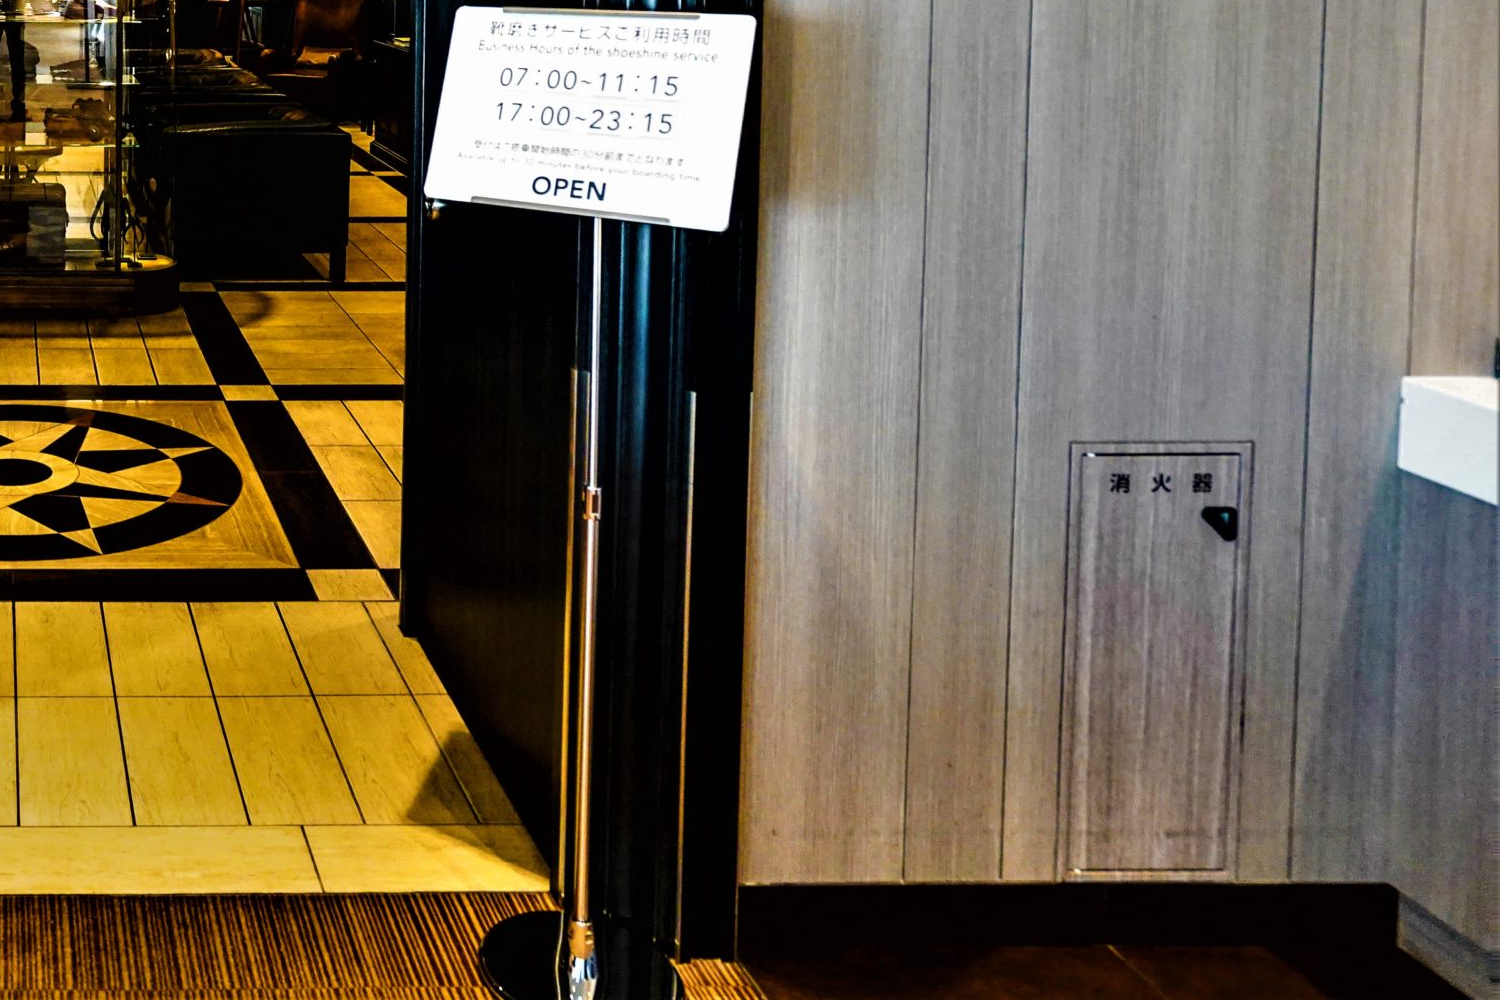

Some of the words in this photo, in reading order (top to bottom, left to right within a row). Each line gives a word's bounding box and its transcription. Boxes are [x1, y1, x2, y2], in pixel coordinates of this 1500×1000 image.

[478, 39, 525, 52] Business
[530, 42, 563, 55] Hours
[567, 43, 580, 56] of
[584, 44, 603, 57] the
[607, 46, 668, 61] shoeshine
[673, 51, 719, 63] service
[531, 176, 607, 202] OPEN
[1110, 472, 1213, 493] 消火器
